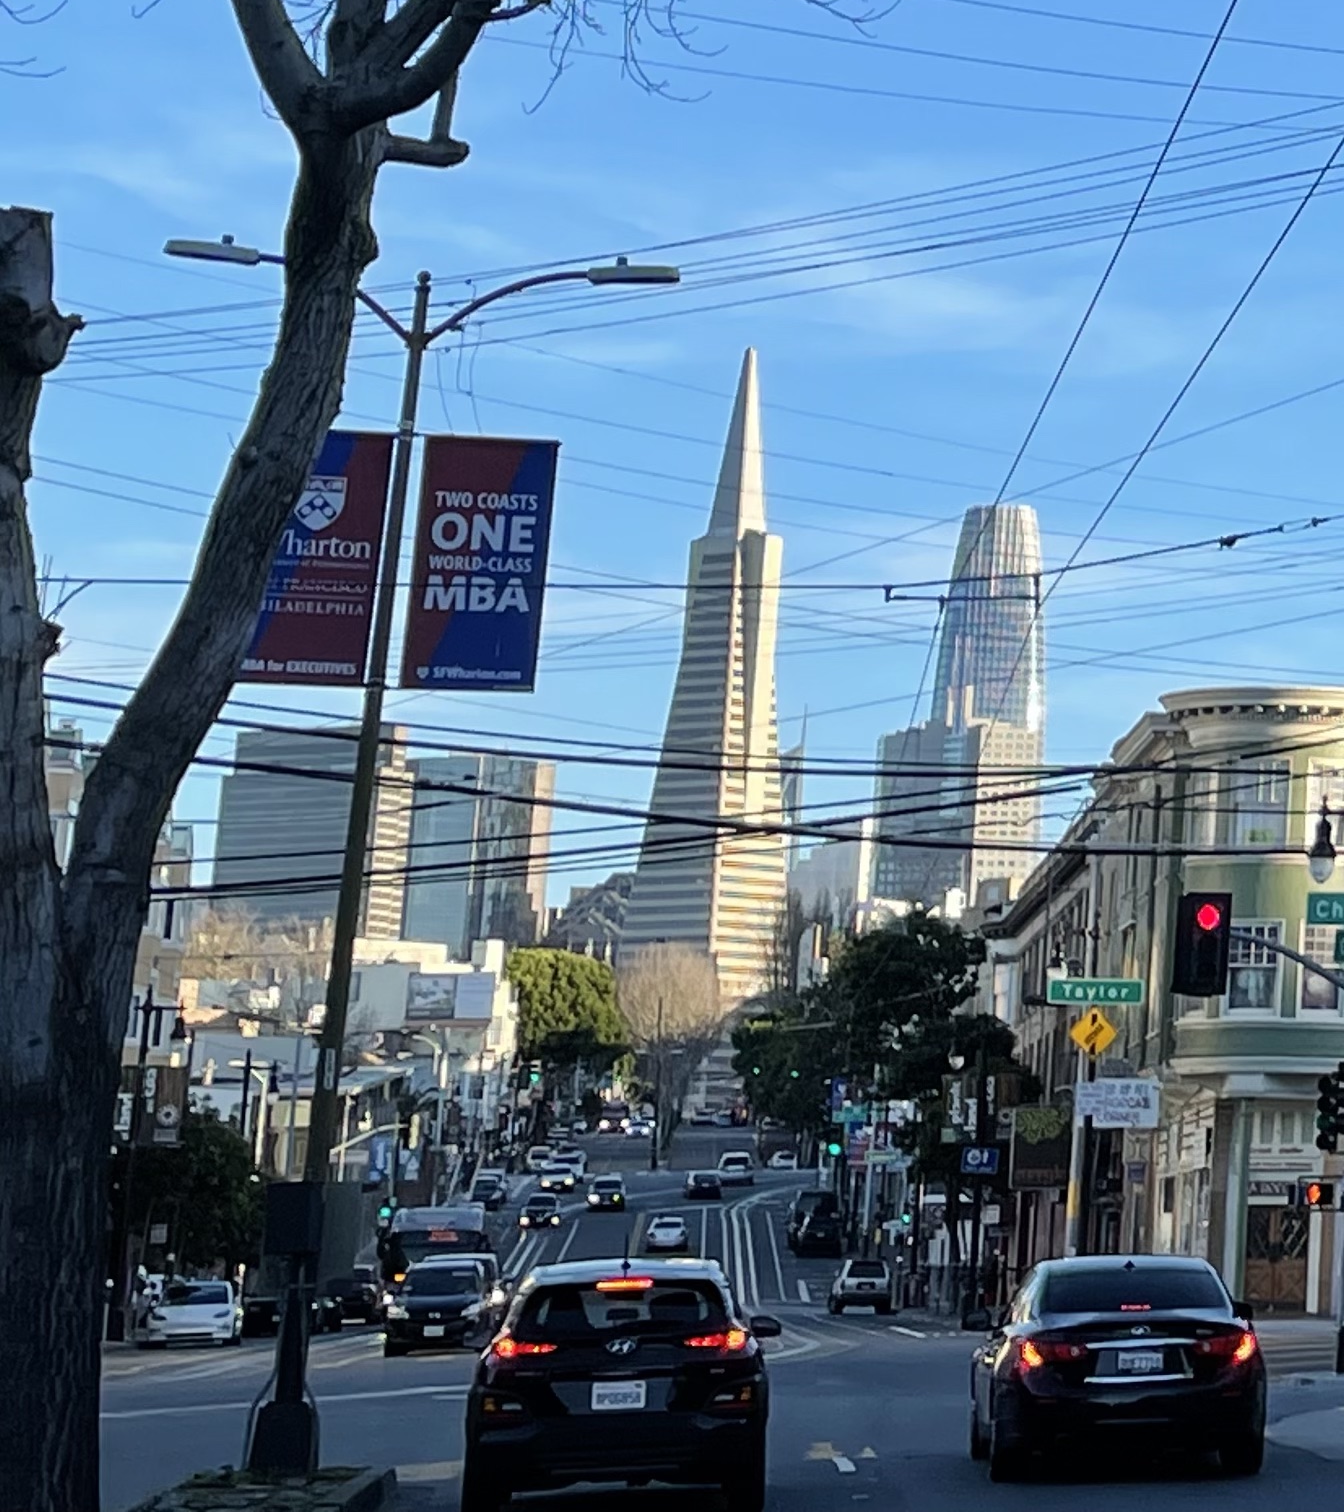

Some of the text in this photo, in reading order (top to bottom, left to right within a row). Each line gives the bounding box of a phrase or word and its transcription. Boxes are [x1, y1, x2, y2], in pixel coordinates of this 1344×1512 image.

[435, 490, 539, 511] TWO COASTS
[431, 511, 538, 553] ONE
[428, 554, 533, 574] WORLD-CLASS
[423, 574, 530, 613] MBA
[261, 599, 365, 617] ILADELPHIA
[285, 660, 357, 676] EXECUTIVES
[1062, 983, 1130, 1001] Taylor
